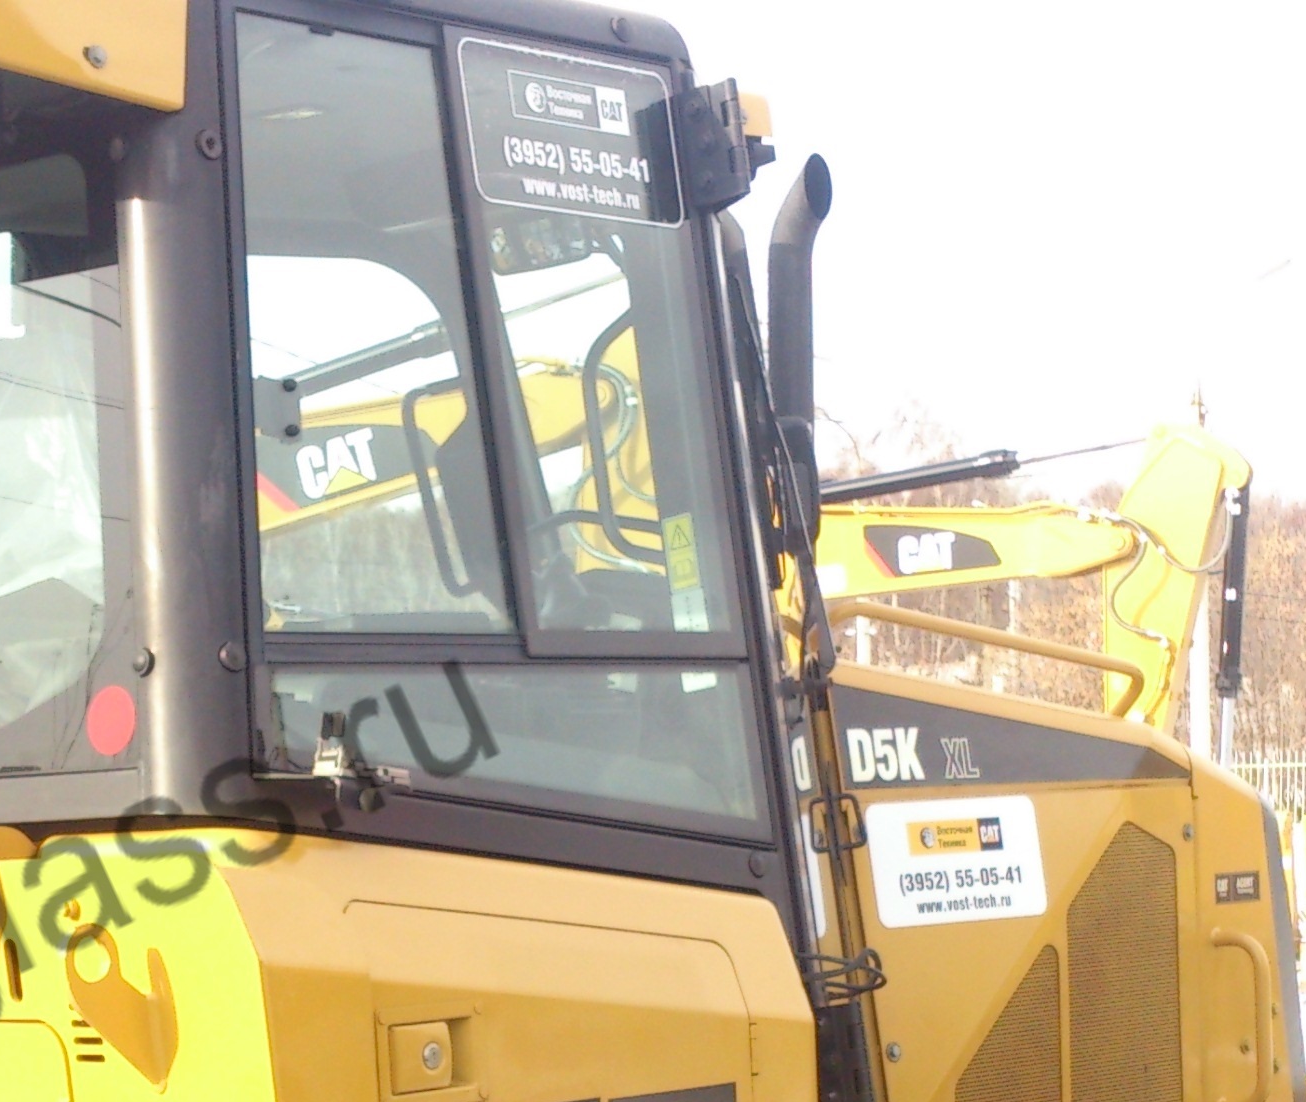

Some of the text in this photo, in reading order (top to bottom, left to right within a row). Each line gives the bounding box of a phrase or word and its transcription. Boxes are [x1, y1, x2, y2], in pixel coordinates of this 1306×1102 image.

[601, 100, 623, 122] CAT
[503, 136, 650, 183] (3952) 55-05-41
[522, 178, 641, 210] www.vost-tech.ru
[296, 427, 377, 500] CAT
[898, 531, 956, 575] CAT
[846, 727, 925, 782] D5K
[940, 737, 981, 779] XL
[979, 824, 999, 843] CAT
[899, 865, 1023, 896] (3952) 55-05-41
[916, 895, 1012, 914] www.vost-tech.ru
